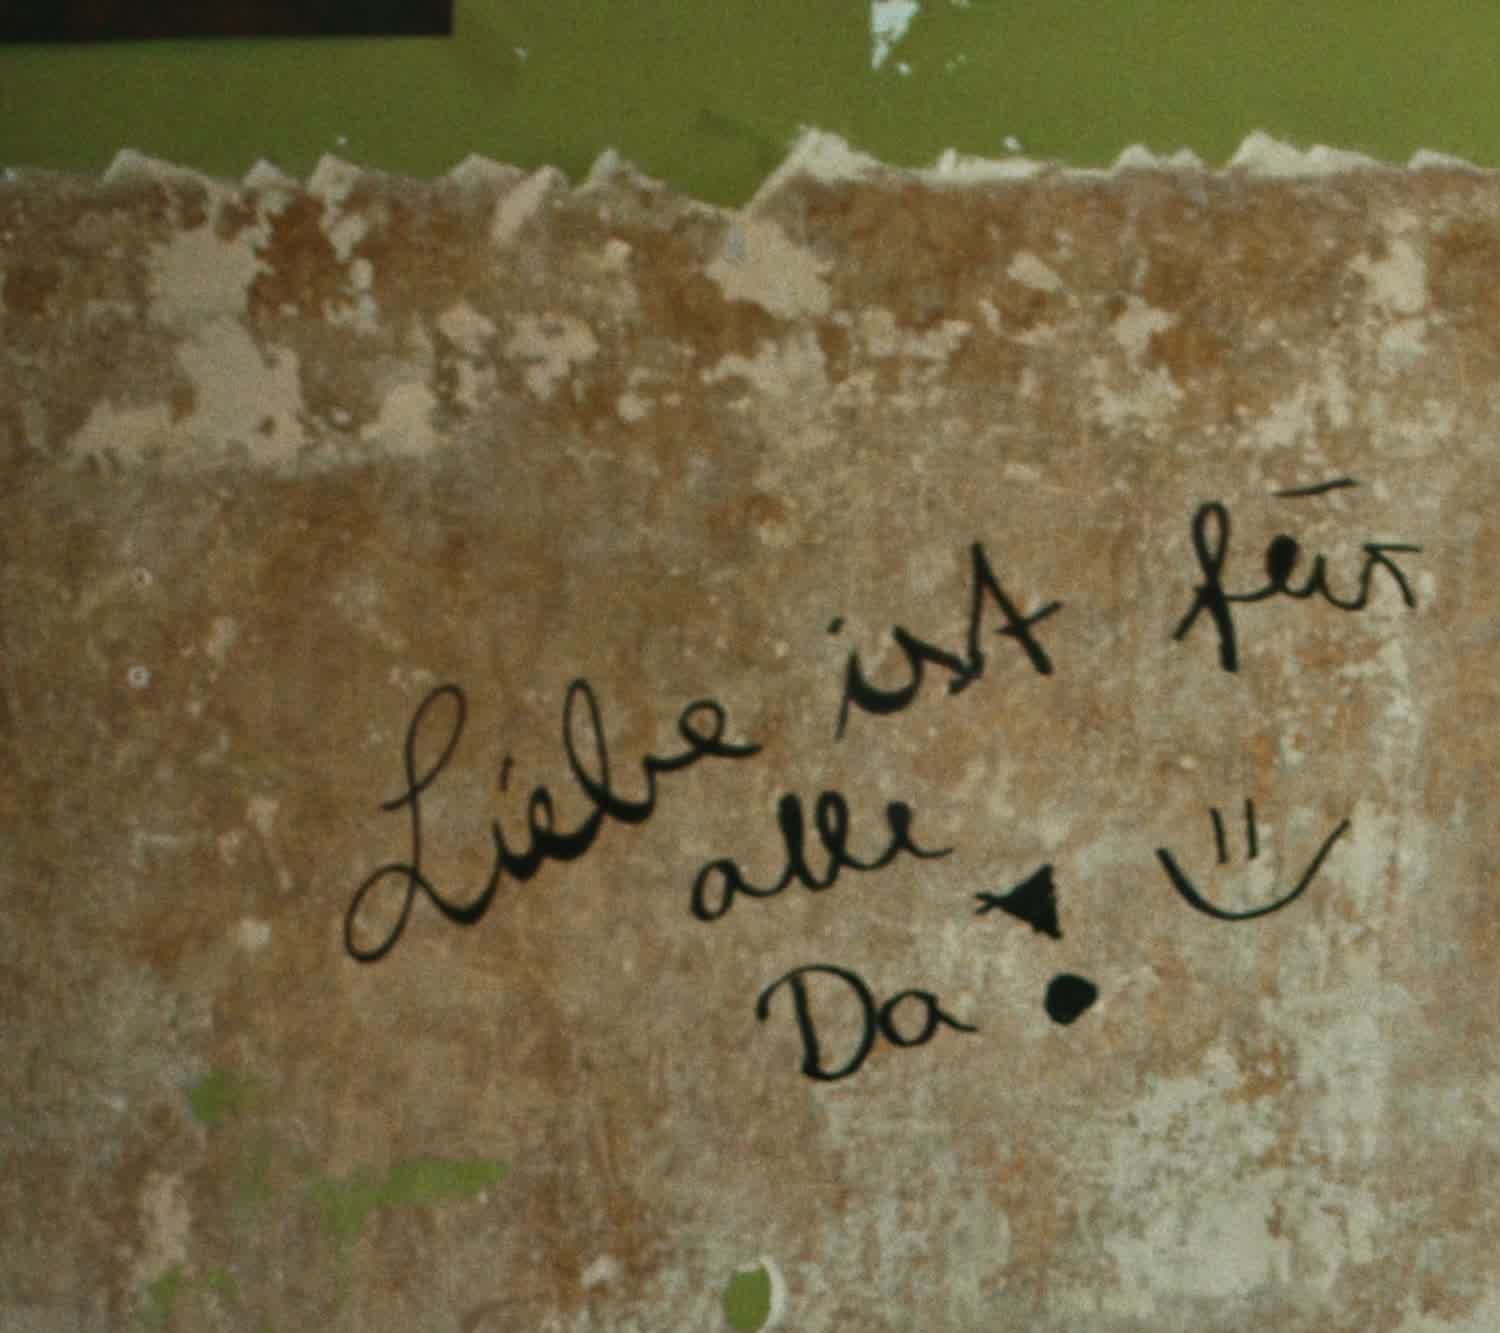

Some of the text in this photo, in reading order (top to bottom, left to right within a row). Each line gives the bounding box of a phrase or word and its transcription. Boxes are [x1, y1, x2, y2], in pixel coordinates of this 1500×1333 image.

[344, 678, 764, 964] Liebe
[826, 541, 1062, 742] ist
[690, 791, 952, 923] alle
